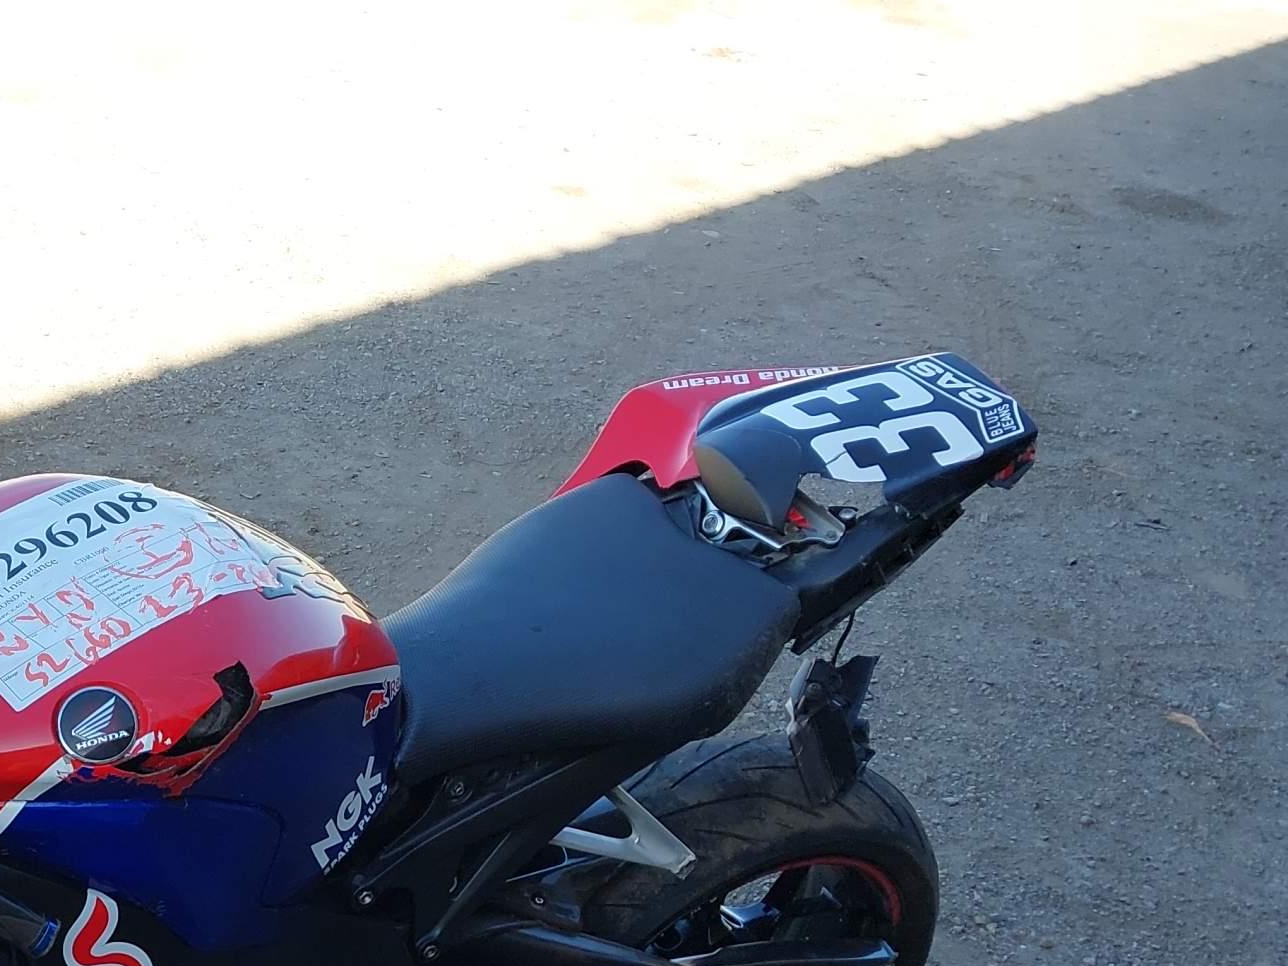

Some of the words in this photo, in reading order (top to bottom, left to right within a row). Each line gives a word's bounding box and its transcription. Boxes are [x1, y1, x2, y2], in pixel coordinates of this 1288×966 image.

[662, 373, 751, 390] Dream
[909, 360, 1003, 408] GAS
[760, 371, 985, 483] 33
[985, 408, 1004, 436] BLUE
[998, 403, 1017, 431] JEANS
[3, 558, 59, 593] Insurance
[75, 730, 130, 750] HONDA
[311, 756, 382, 869] NGK
[324, 831, 359, 876] SPARK
[358, 783, 388, 831] PLUGS
